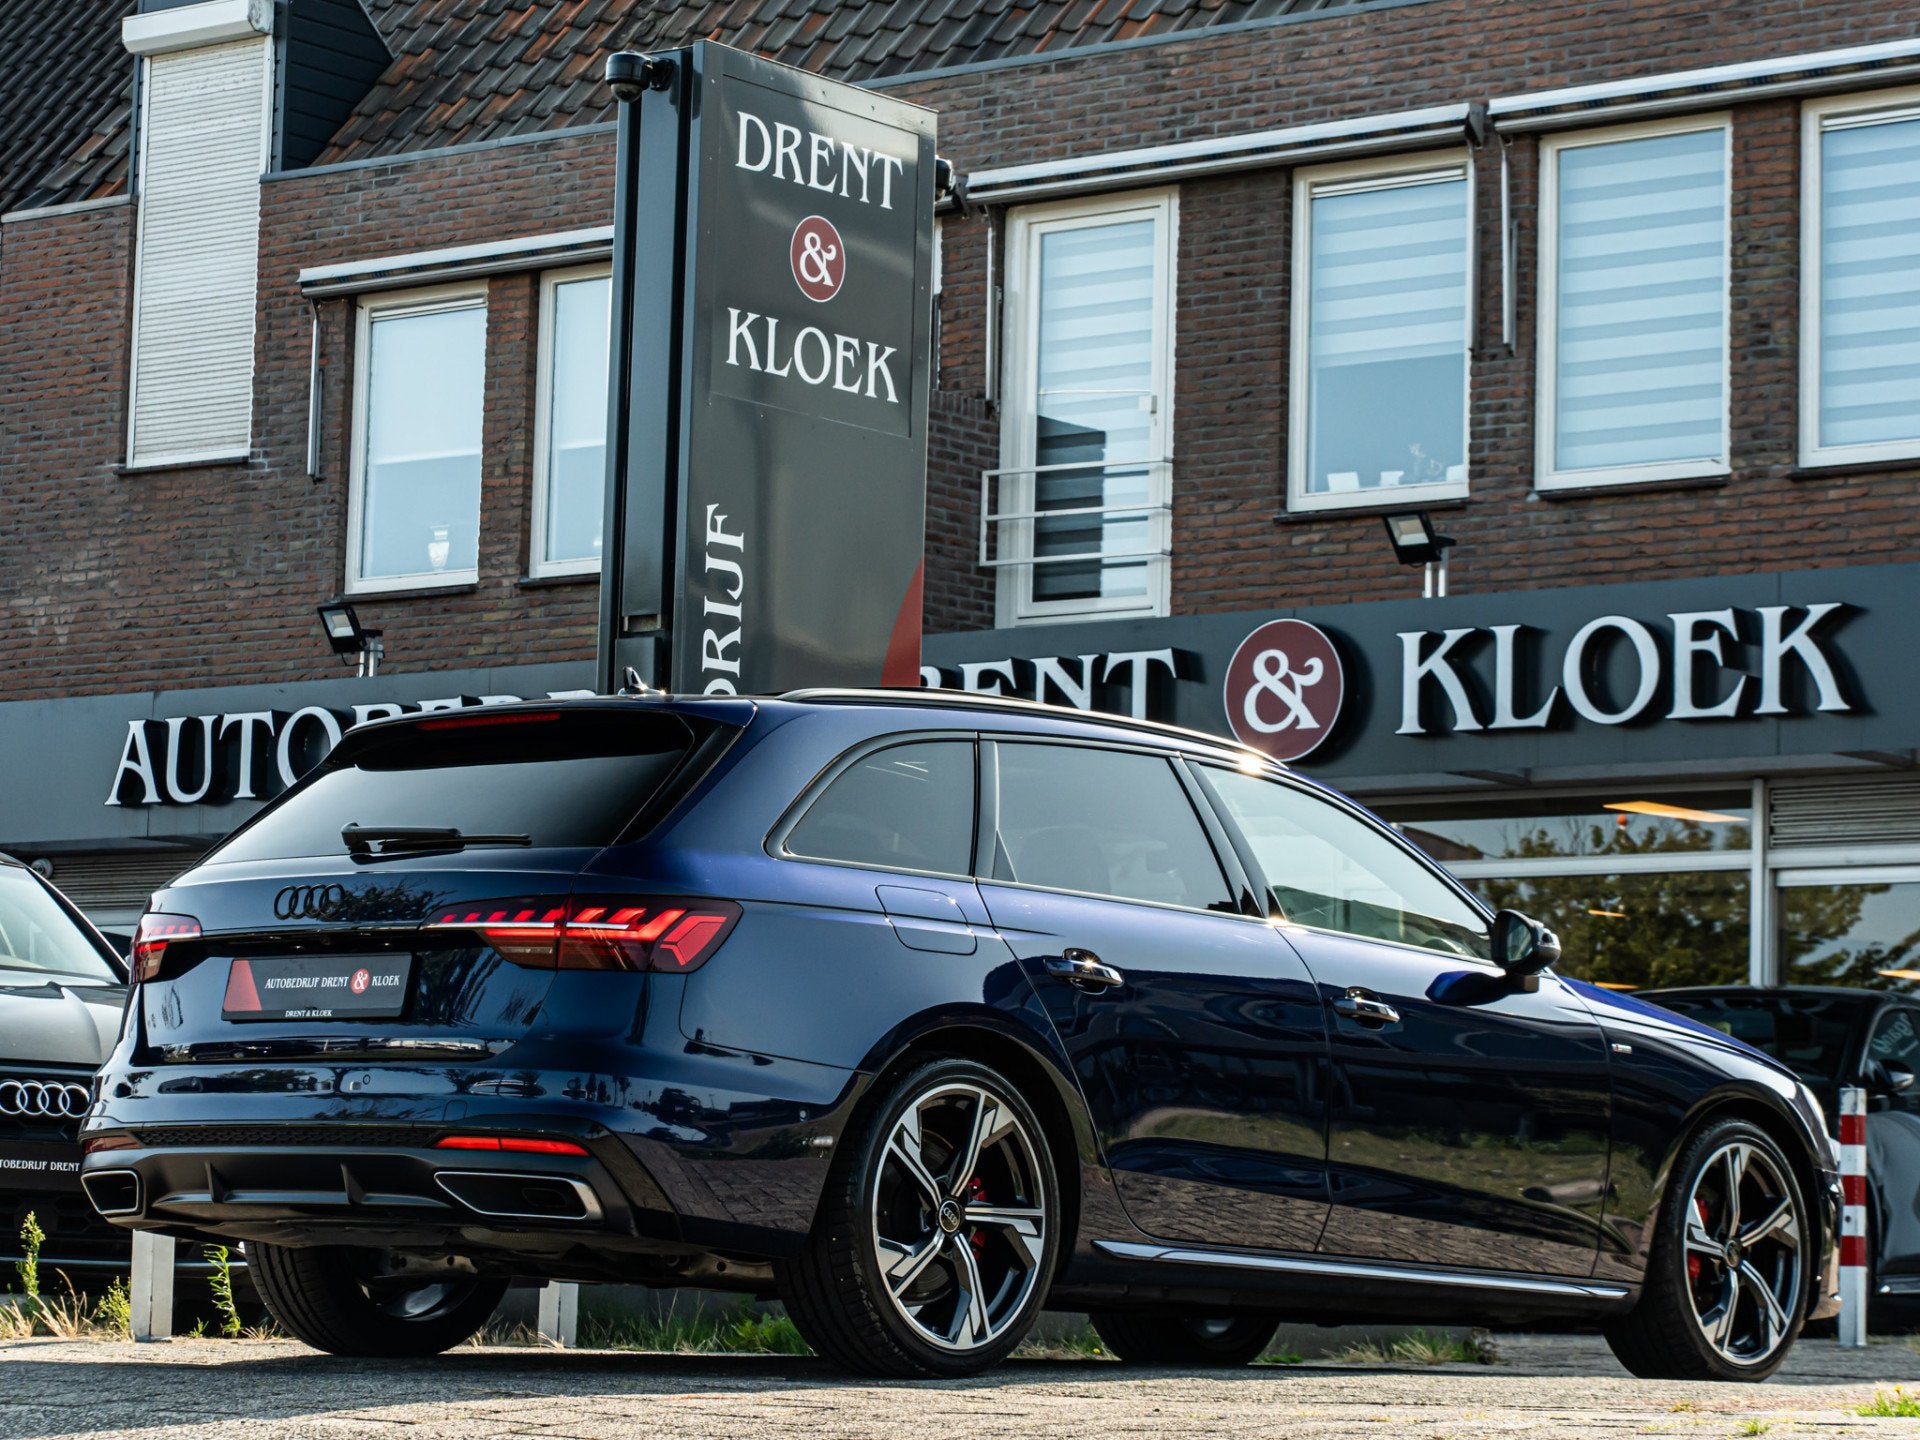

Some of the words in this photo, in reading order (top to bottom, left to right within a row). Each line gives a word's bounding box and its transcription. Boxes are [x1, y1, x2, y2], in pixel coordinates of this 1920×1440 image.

[735, 111, 903, 210] DRENT
[800, 232, 836, 287] &
[726, 307, 899, 404] KLOEK
[1243, 648, 1324, 733] &
[1395, 602, 1851, 735] KLOEK
[265, 977, 320, 989] AUTOBEDRIJF
[321, 976, 349, 988] DRENT
[353, 971, 368, 990] &
[371, 975, 400, 986] KLOEK
[285, 1010, 306, 1018] DRENT
[312, 1009, 333, 1017] KLOEK
[50, 1161, 81, 1172] DRENT
